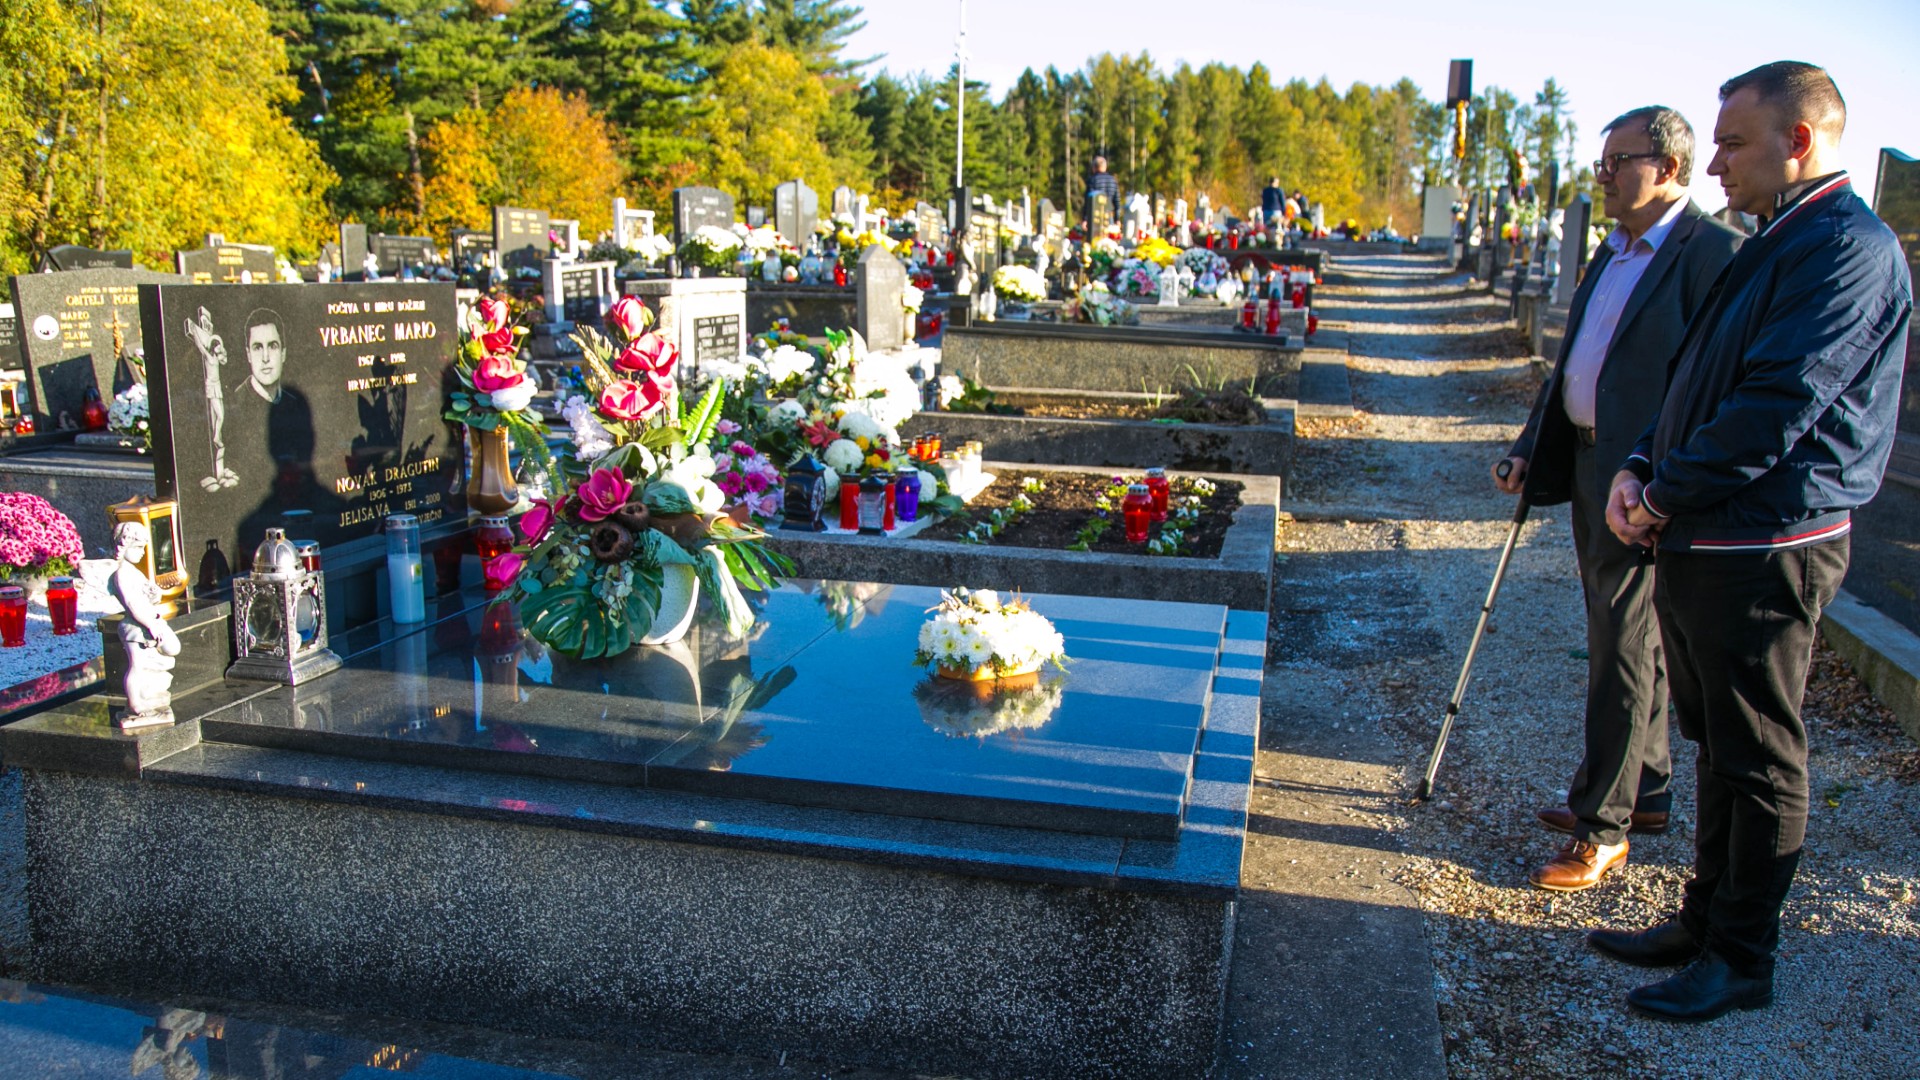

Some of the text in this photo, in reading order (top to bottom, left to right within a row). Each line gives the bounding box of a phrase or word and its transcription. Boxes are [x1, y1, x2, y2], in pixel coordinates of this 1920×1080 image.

[327, 301, 360, 315] POČIVA
[363, 302, 371, 313] U
[374, 301, 395, 313] MIRU
[319, 321, 437, 348] VRBANEC MARIO
[347, 373, 418, 392] HRVATSKI VOJNIK
[336, 457, 439, 493] NOVAK DRAGUTIN
[339, 502, 391, 527] JELISAVA
